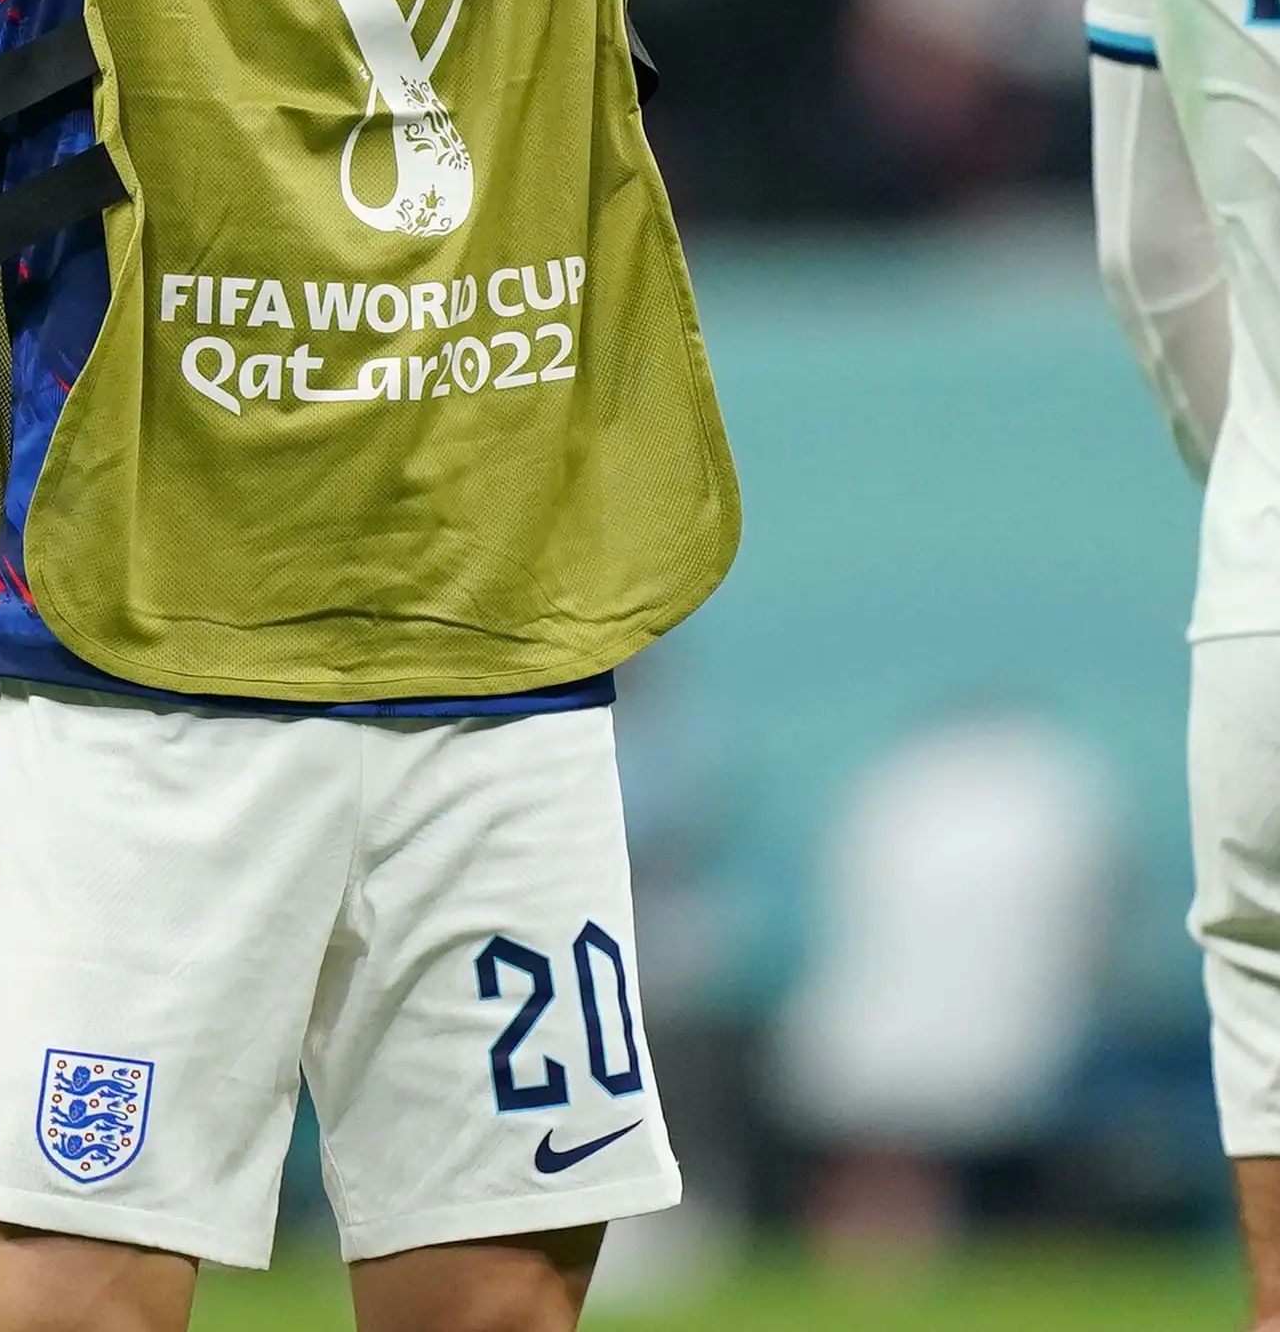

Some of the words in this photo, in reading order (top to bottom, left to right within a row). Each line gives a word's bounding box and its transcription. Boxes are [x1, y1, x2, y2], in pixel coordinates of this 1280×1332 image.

[160, 273, 296, 330] FIFA
[303, 274, 478, 334] WORLD
[486, 255, 586, 318] CUP
[180, 336, 439, 416] Qatar
[431, 323, 576, 399] 2022
[473, 919, 645, 1116] 20
